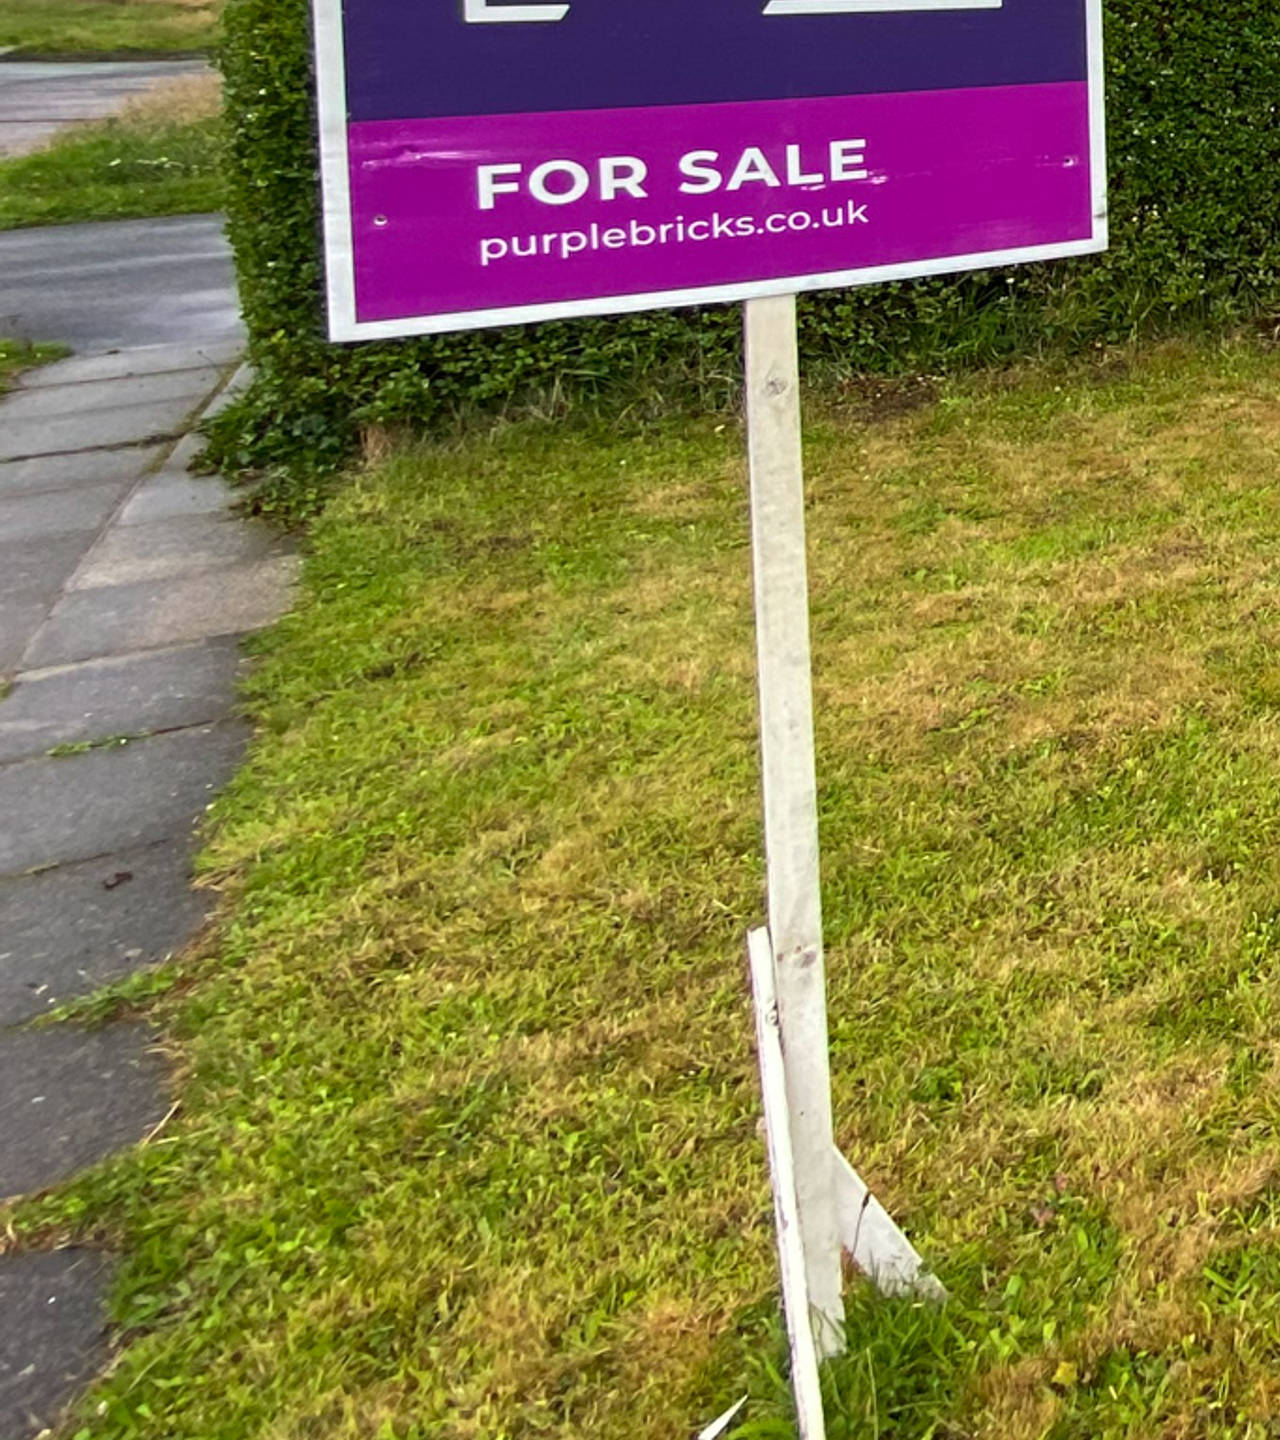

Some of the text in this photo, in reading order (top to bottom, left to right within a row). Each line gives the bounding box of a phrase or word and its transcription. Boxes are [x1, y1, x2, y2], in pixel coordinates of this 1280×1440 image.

[476, 138, 869, 210] FOR SALE
[480, 199, 869, 265] purplebricks.co.uk
